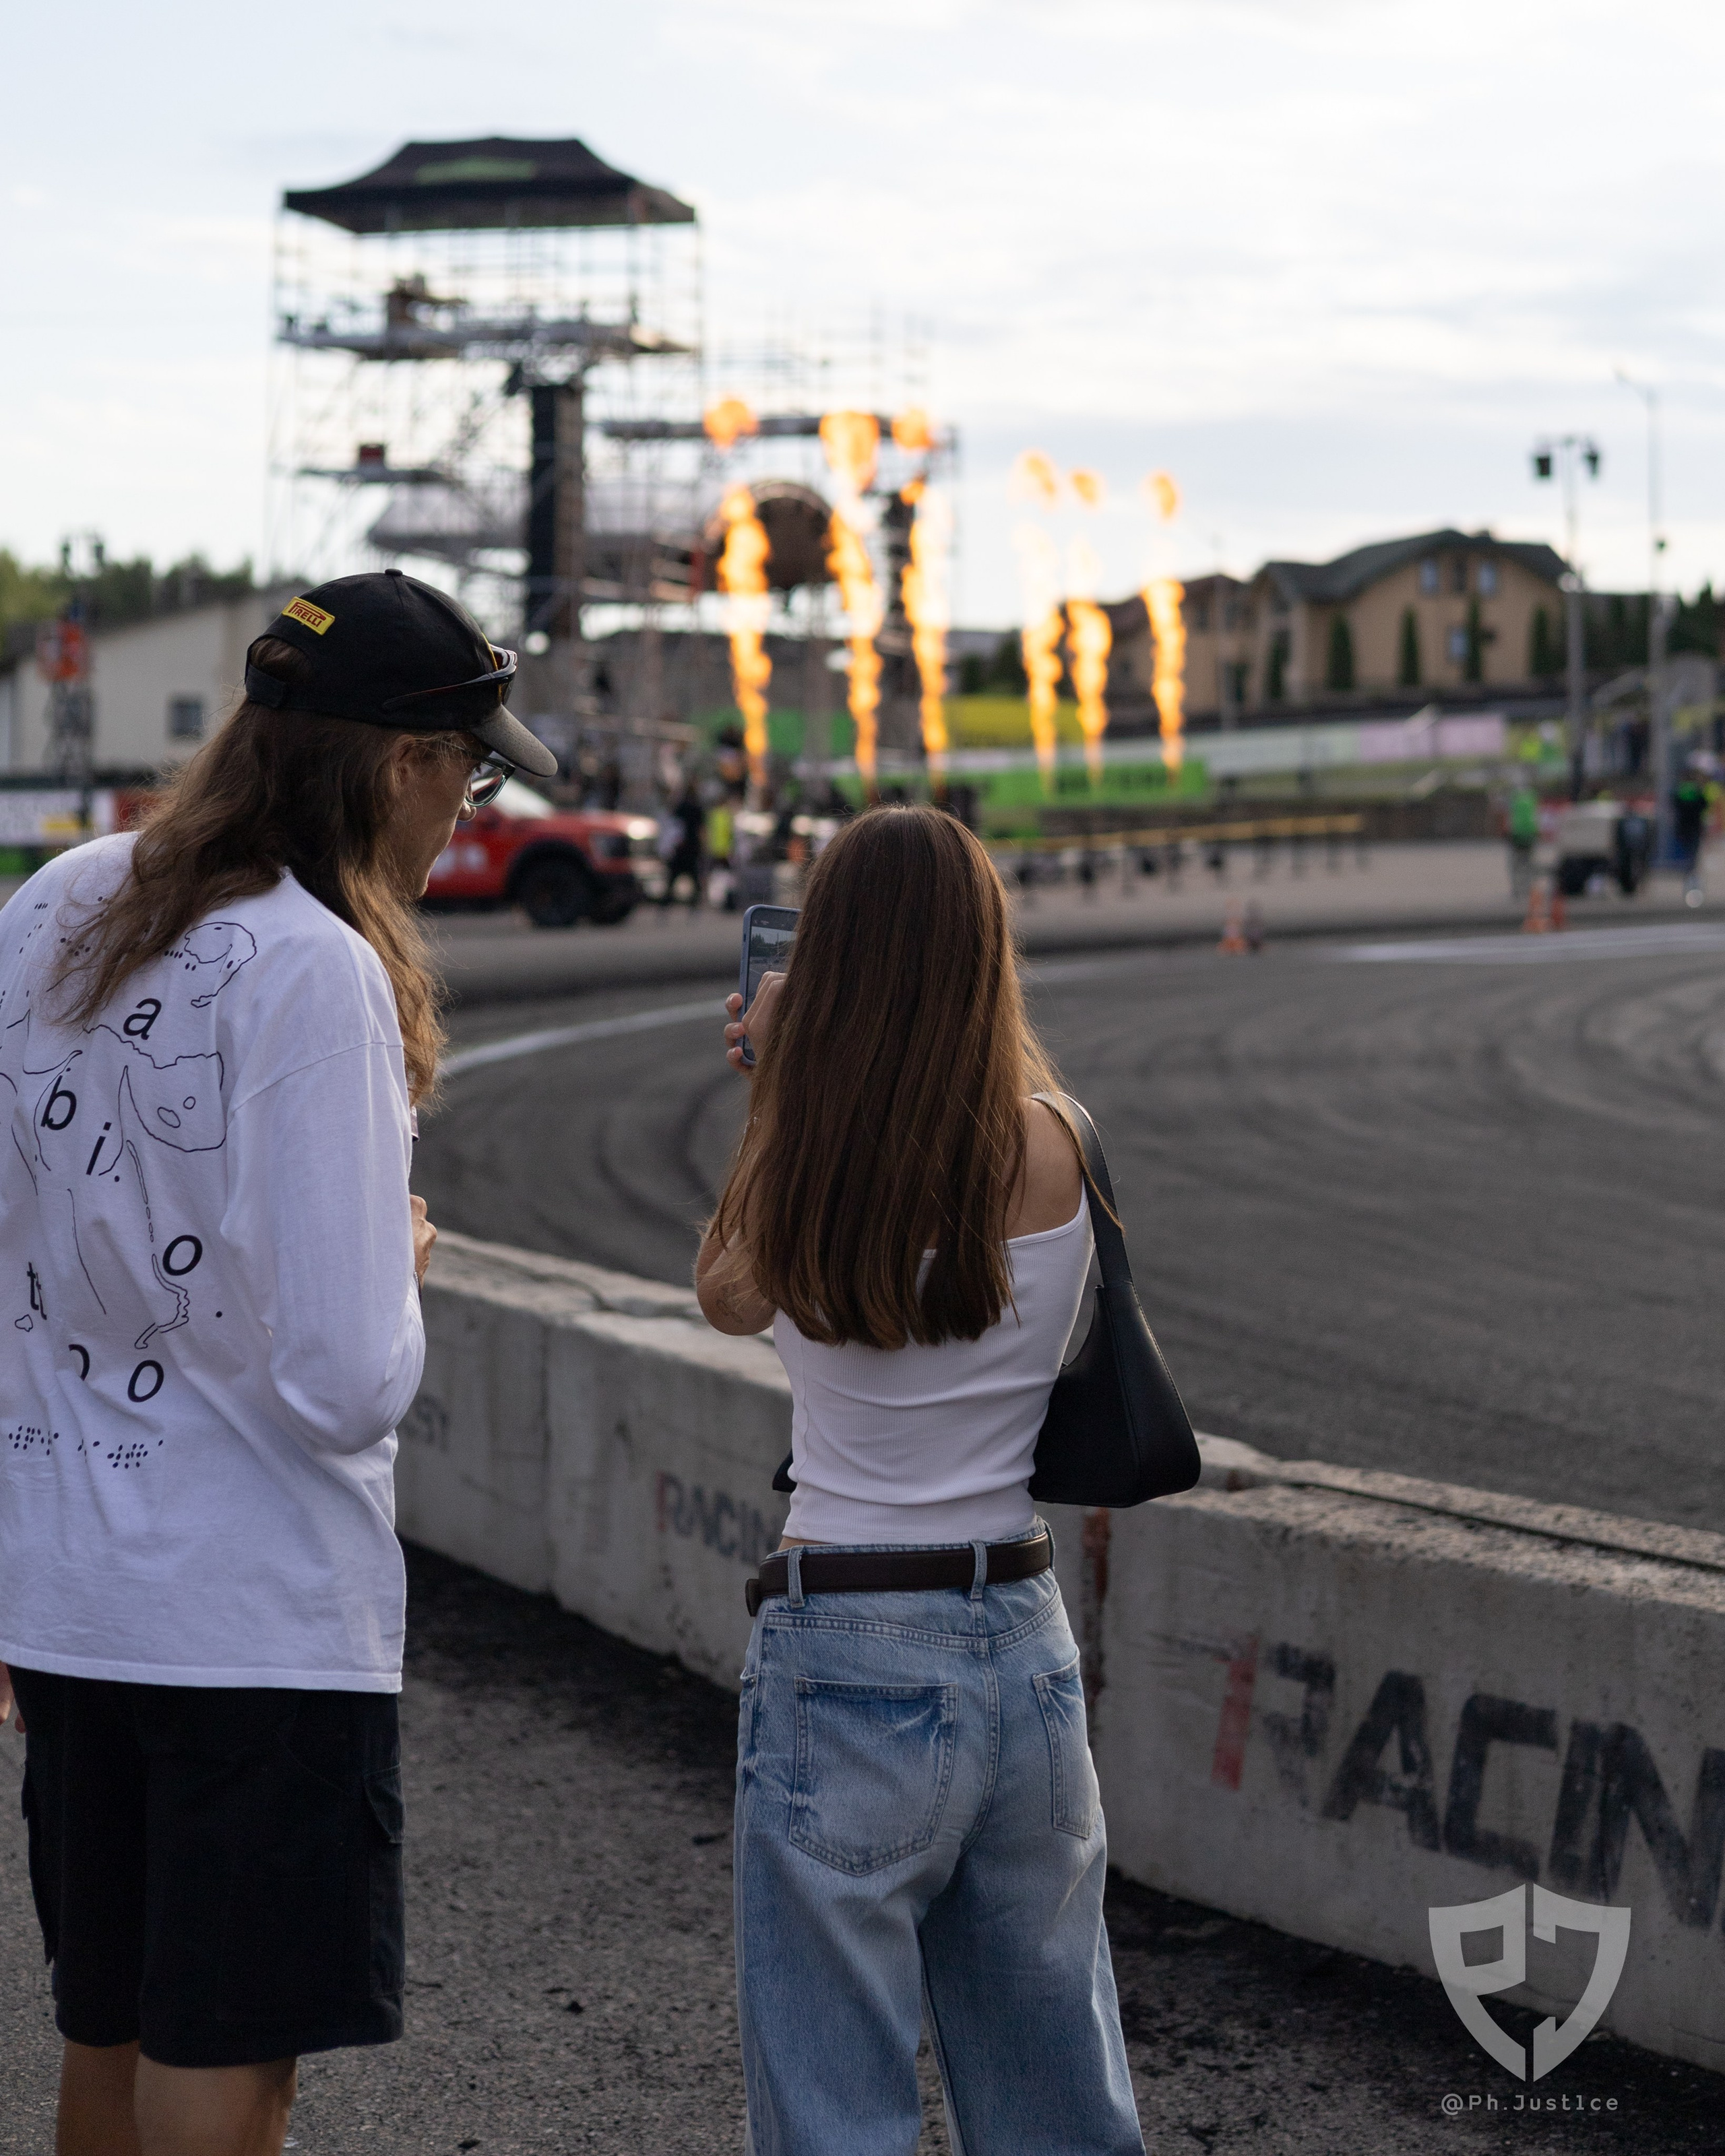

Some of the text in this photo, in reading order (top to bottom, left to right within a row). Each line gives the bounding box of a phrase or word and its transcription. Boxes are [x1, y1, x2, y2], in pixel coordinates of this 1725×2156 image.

[288, 601, 326, 628] PIRELLI
[123, 998, 162, 1040] a
[40, 1075, 77, 1131] b
